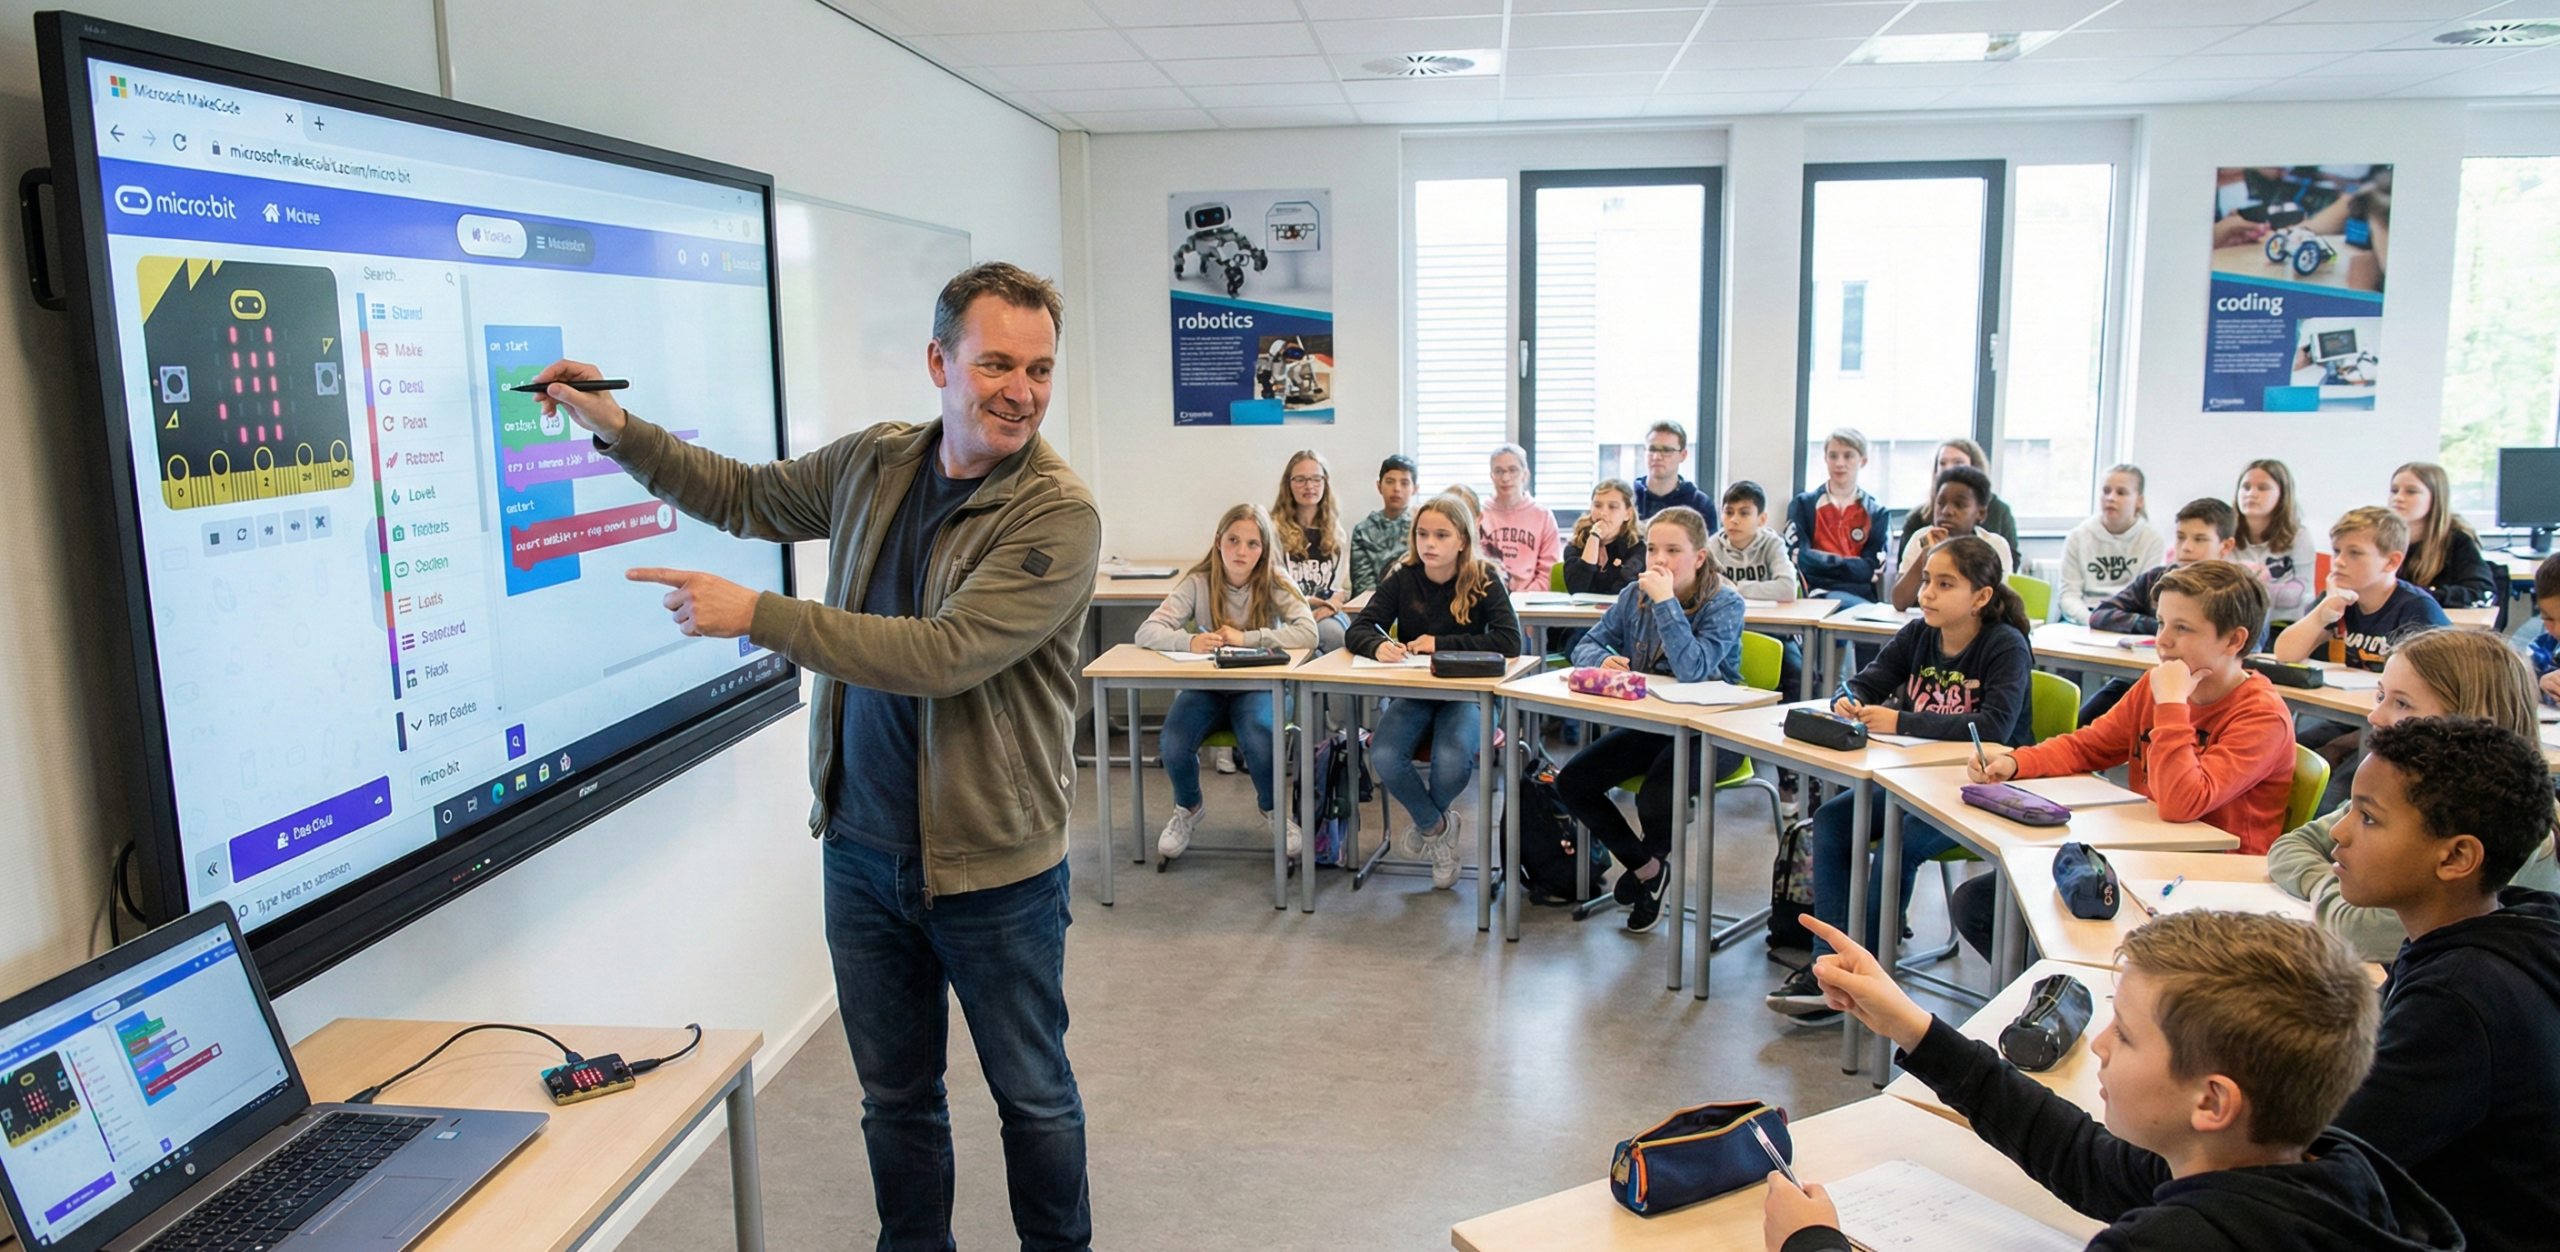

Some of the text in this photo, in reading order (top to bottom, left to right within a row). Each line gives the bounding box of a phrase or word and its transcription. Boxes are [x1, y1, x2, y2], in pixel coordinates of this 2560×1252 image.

[156, 190, 237, 220] micro:bit
[2216, 293, 2284, 317] coding
[1178, 312, 1254, 330] robotics
